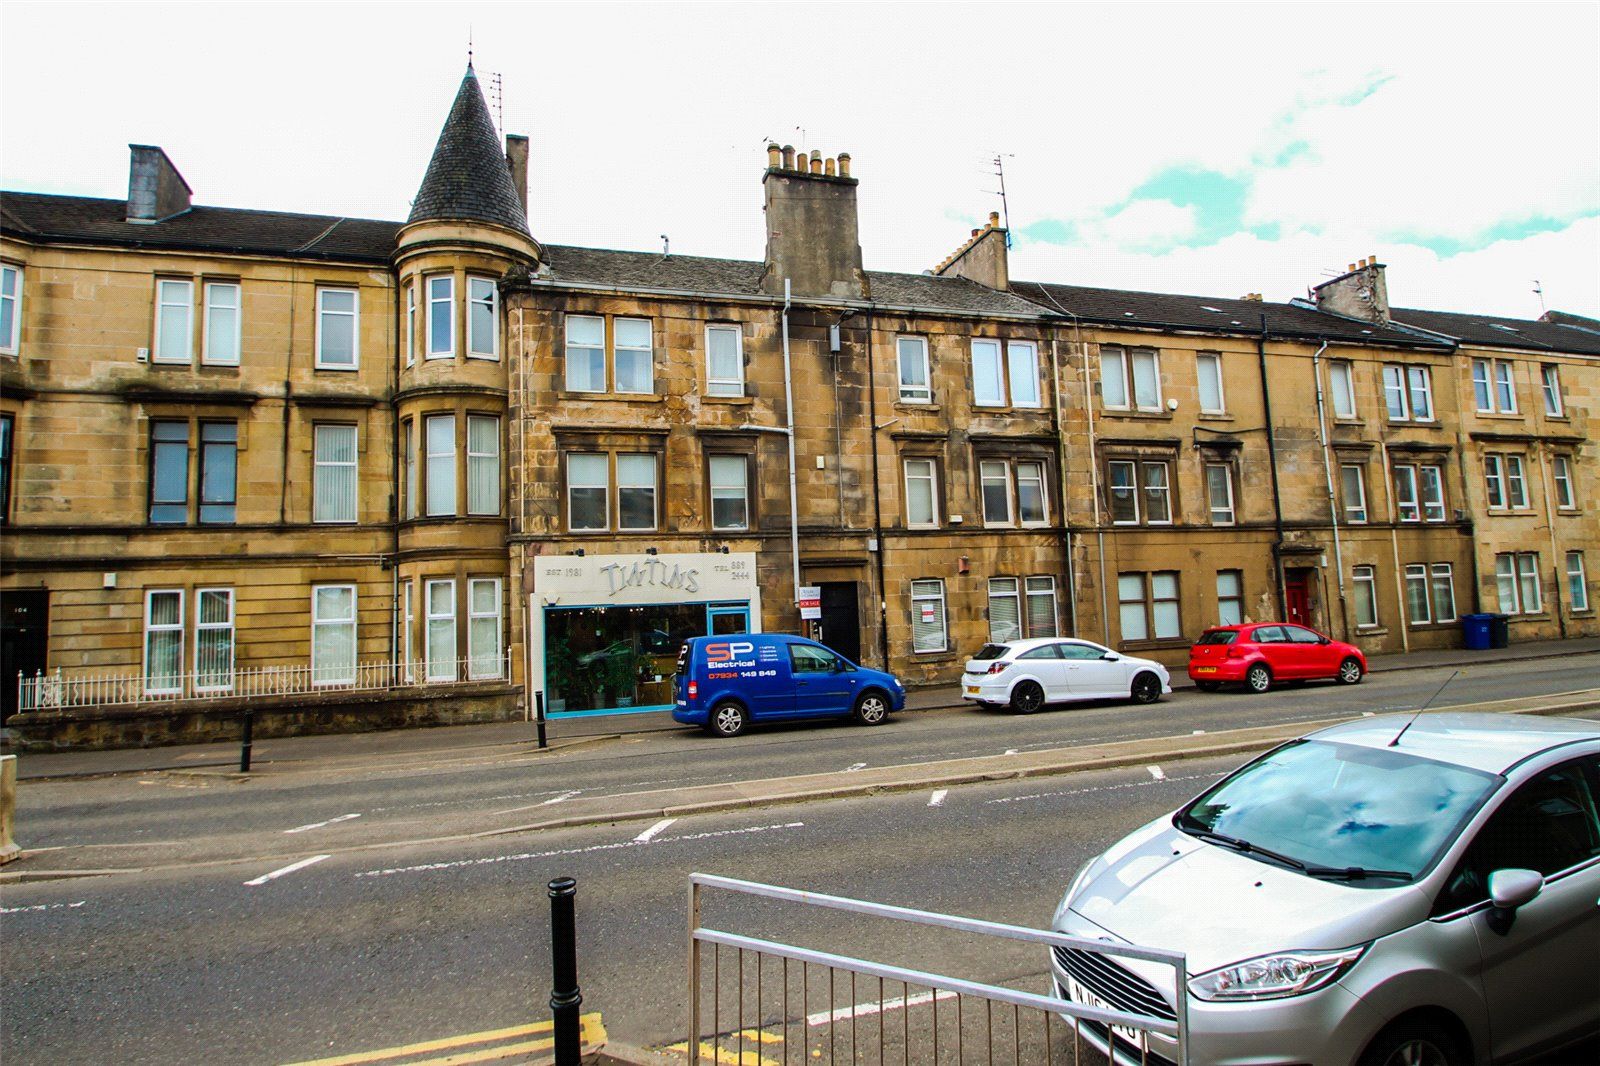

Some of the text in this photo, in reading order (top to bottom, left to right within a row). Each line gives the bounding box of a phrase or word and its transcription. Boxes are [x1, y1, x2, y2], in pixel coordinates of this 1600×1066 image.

[565, 568, 582, 577] 1981
[600, 558, 699, 596] TINTINS
[705, 642, 754, 662] SP
[707, 660, 756, 669] Electrical
